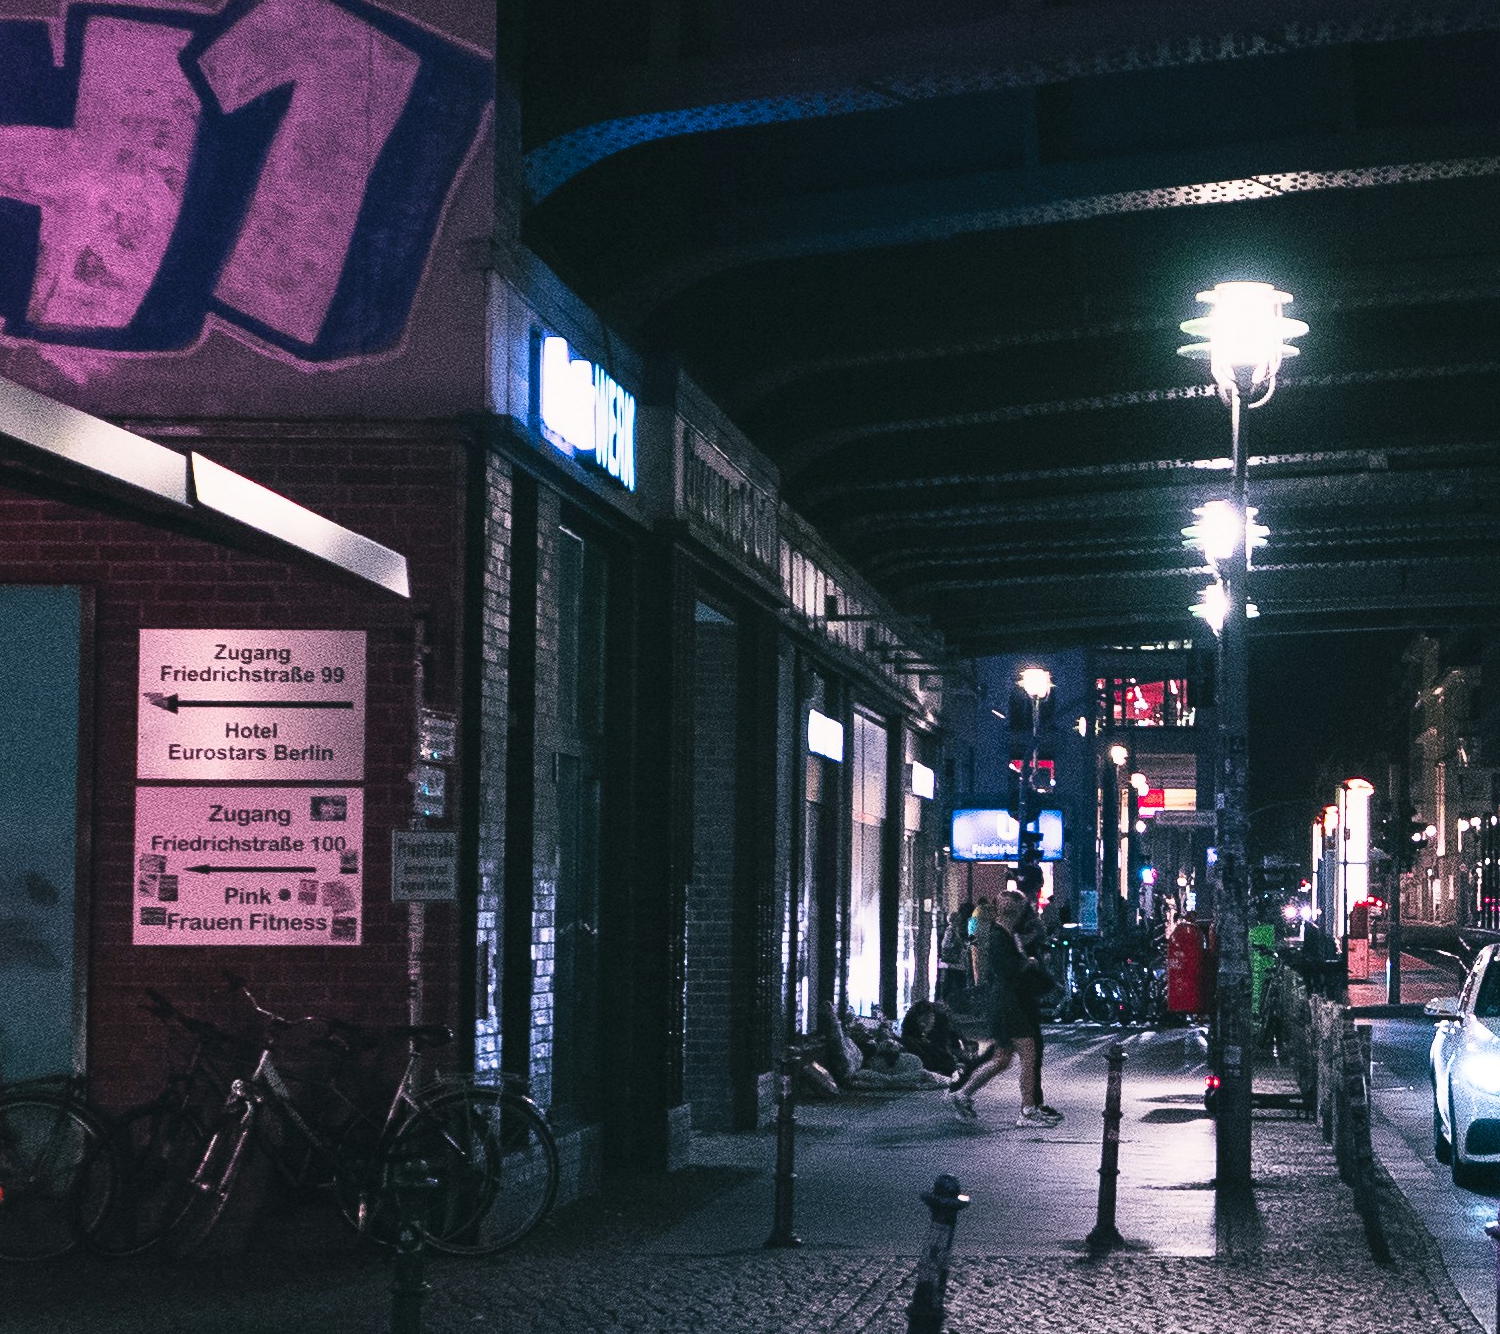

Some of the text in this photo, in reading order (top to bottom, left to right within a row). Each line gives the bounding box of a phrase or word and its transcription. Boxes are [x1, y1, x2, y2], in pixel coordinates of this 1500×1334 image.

[213, 643, 292, 665] Zugang
[159, 665, 346, 684] Friedrichstraße 99
[224, 722, 279, 739] Hotel
[167, 743, 335, 762] Eurostars Berlin
[207, 804, 293, 827] Zugang
[150, 834, 347, 853] Friedrichstraße 100
[223, 886, 273, 906] Pink
[166, 912, 329, 932] Frauen Fitness
